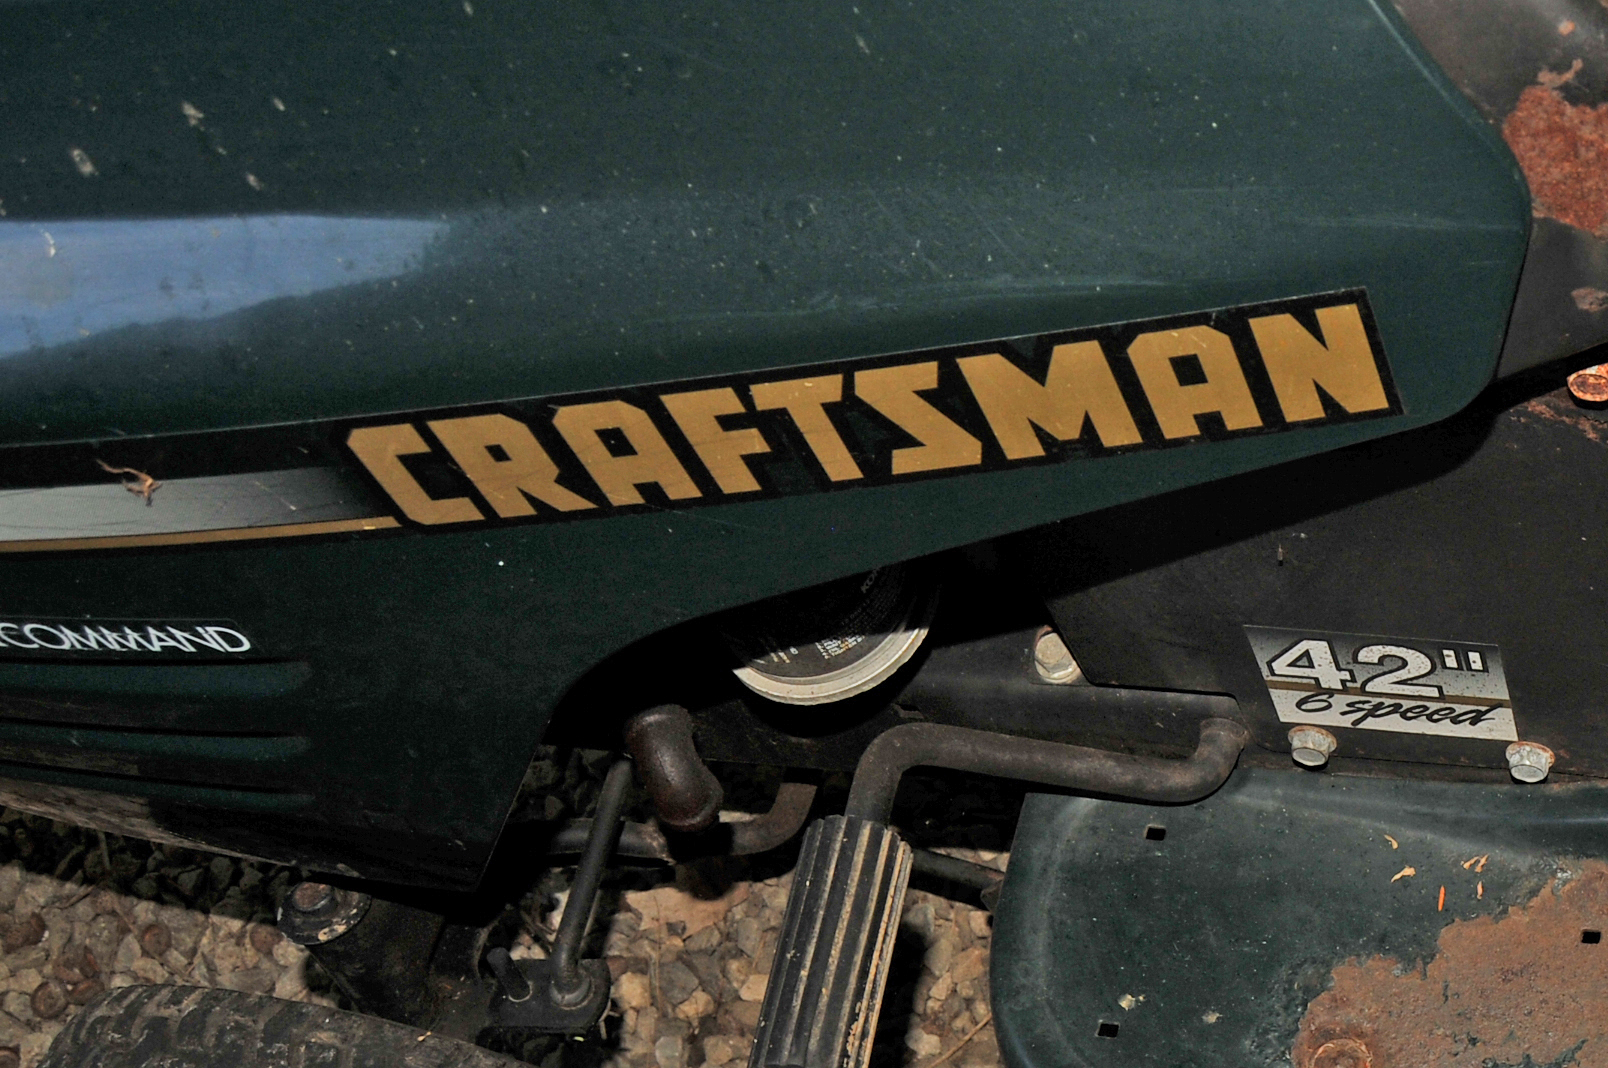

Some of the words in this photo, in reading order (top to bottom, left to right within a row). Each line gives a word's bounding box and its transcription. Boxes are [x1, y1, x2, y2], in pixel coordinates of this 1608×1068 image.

[345, 302, 1391, 526] CRAFTSMAN
[1267, 637, 1488, 699] 42"
[1295, 691, 1334, 714] 6
[1339, 702, 1504, 727] speed
